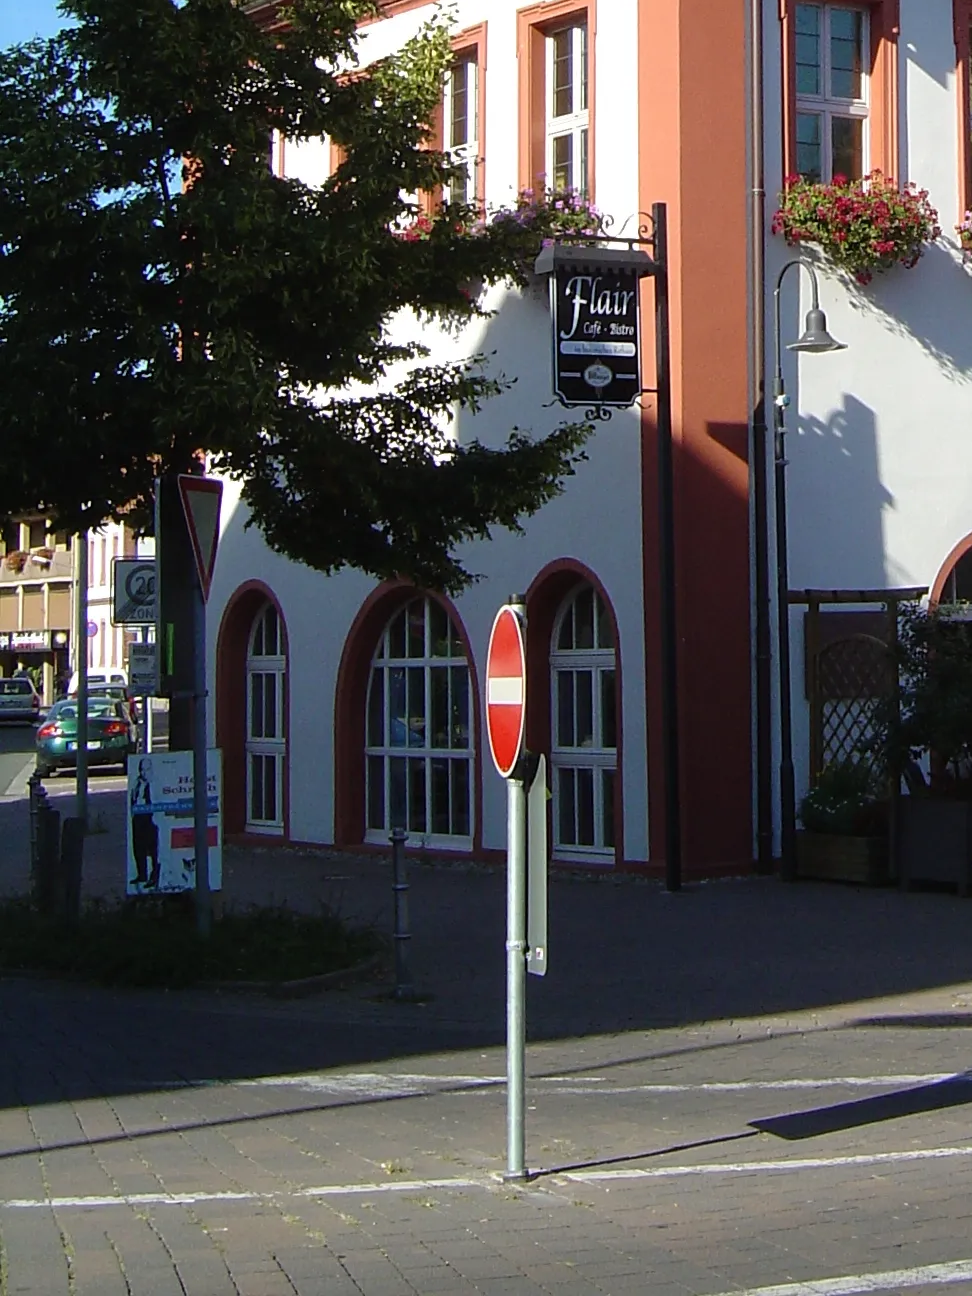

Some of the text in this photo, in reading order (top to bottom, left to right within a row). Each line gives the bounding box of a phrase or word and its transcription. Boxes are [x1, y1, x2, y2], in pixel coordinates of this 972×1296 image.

[560, 276, 635, 339] Flair
[583, 320, 635, 338] Café Bistro
[135, 576, 156, 595] 20
[129, 608, 155, 619] ZON
[162, 784, 217, 795] Schrh
